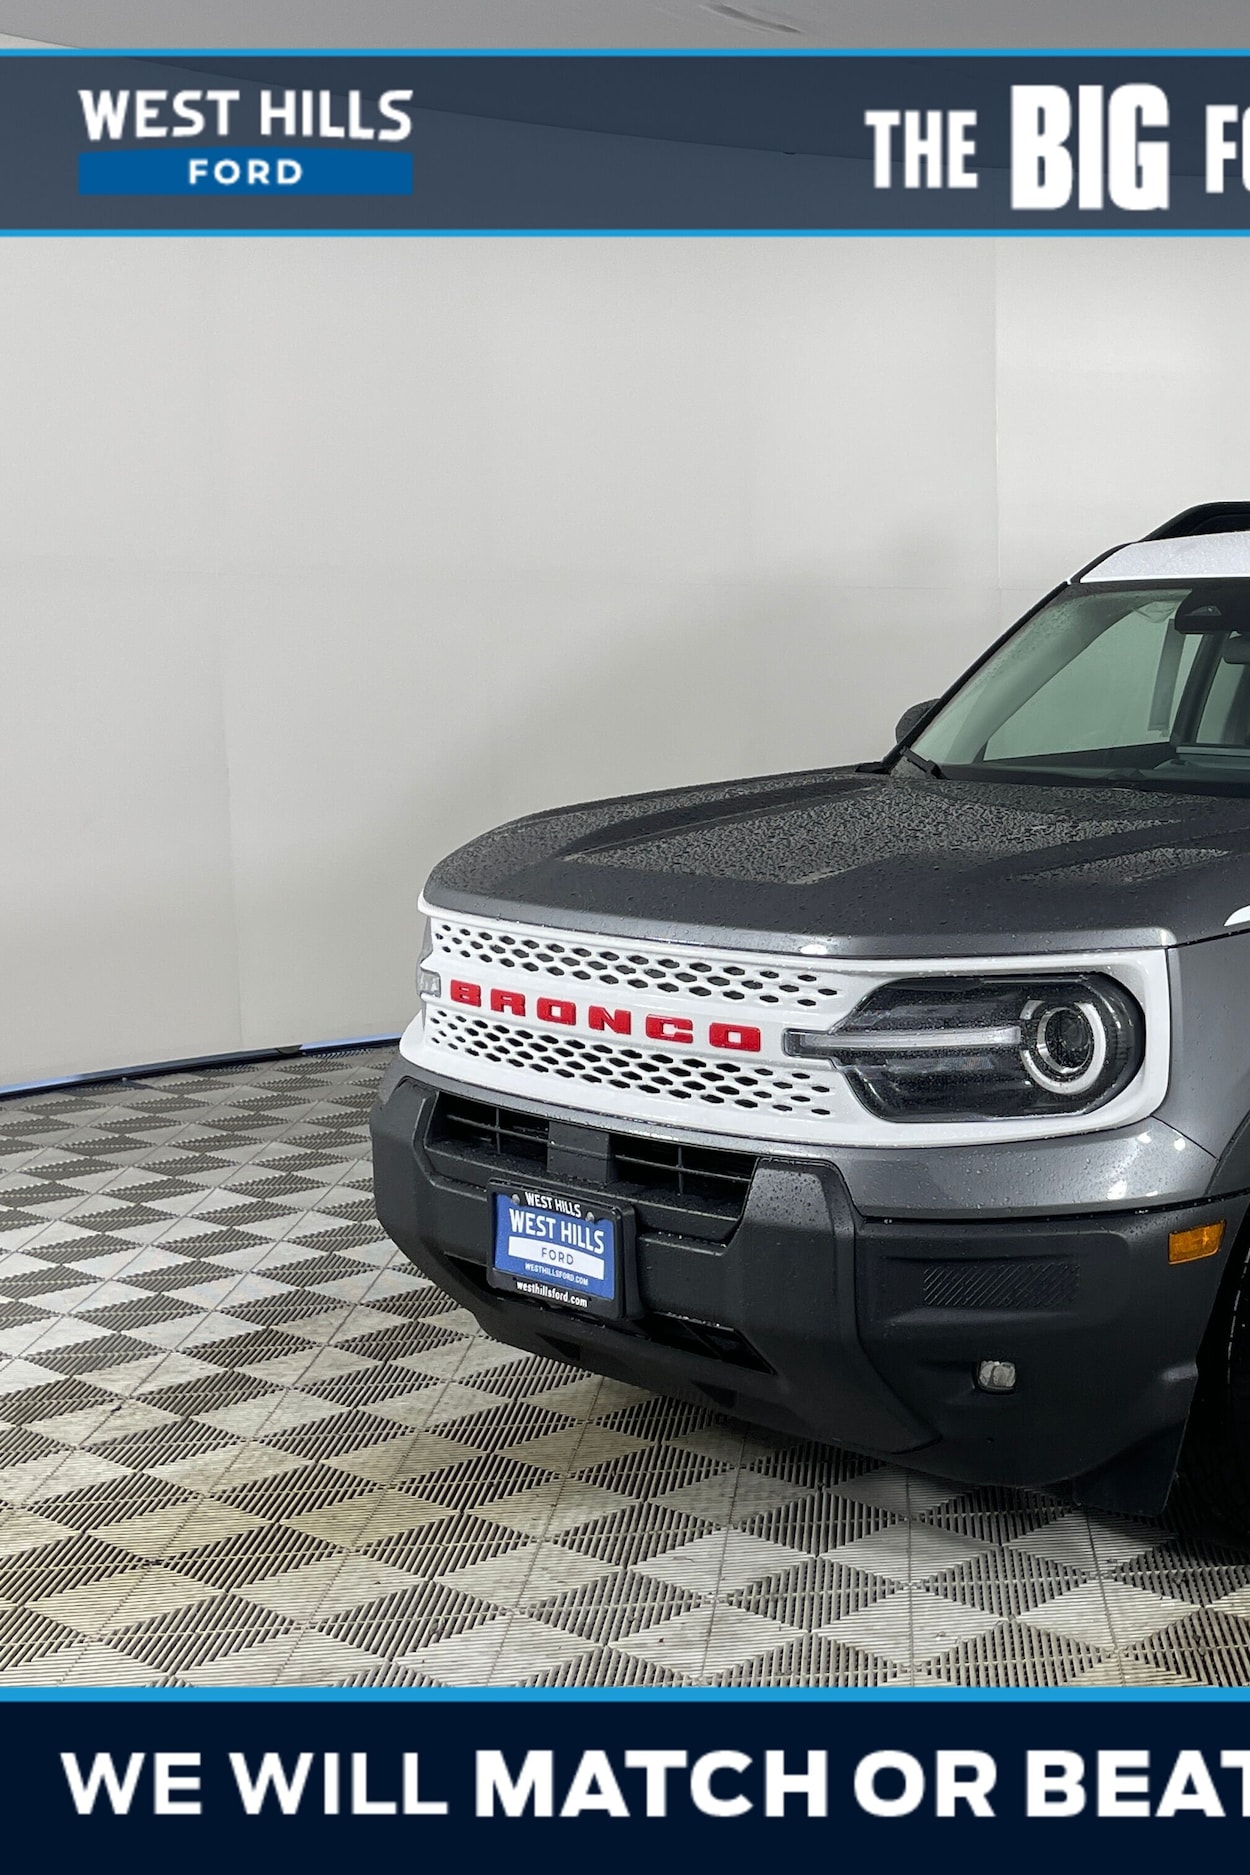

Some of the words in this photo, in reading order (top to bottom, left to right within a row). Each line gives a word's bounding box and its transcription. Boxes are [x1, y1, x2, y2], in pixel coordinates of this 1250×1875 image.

[450, 979, 761, 1053] BRONCO
[525, 1192, 552, 1210] WEST
[554, 1199, 582, 1218] HILLS
[509, 1208, 556, 1239] WEST
[560, 1220, 605, 1254] HILLS
[541, 1247, 574, 1265] FORD
[525, 1263, 589, 1286] WESTHILLSFORD.COM
[516, 1281, 588, 1308] westhillsford.com
